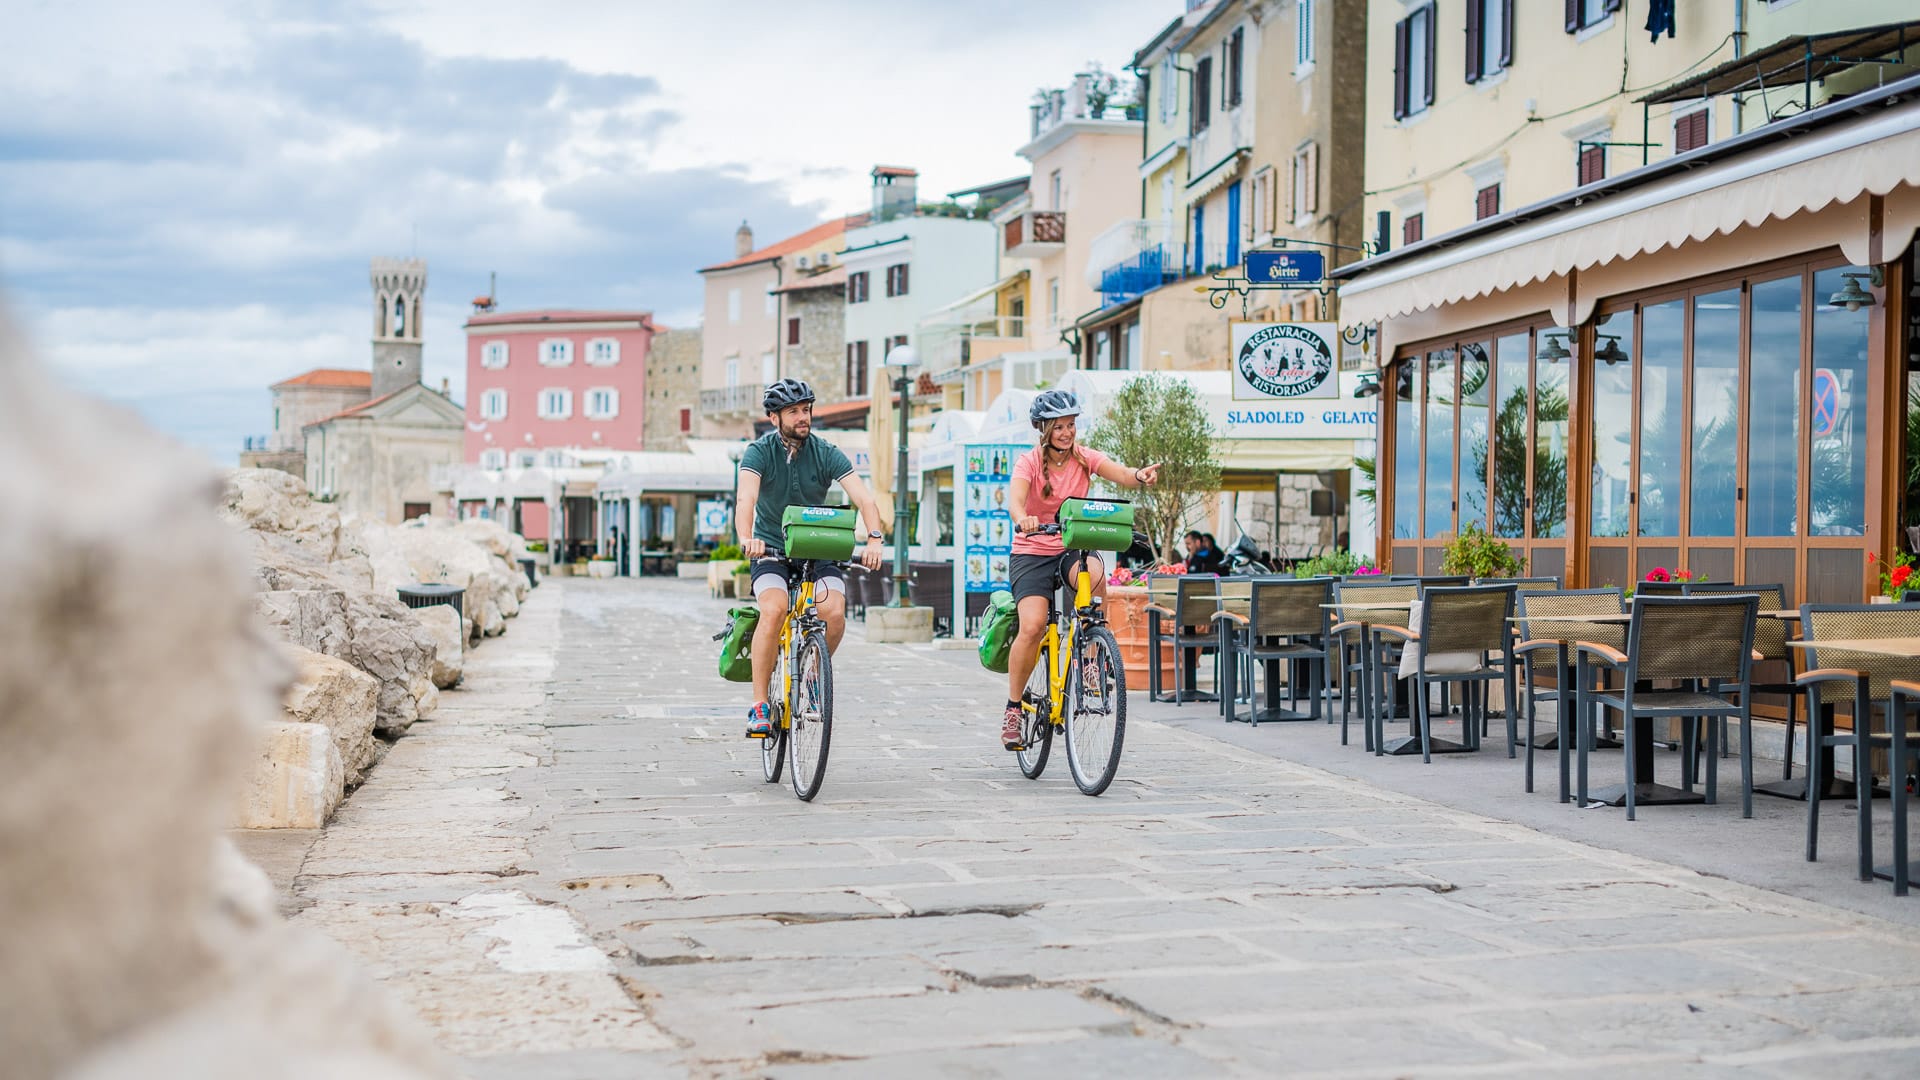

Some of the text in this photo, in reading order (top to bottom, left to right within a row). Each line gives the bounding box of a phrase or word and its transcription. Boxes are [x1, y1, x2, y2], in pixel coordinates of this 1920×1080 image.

[1269, 265, 1300, 279] Hirter
[1247, 326, 1321, 350] RESTAVRACIJA
[1252, 376, 1319, 396] RISTORANTE
[1227, 411, 1377, 424] SLADOLED GELATO
